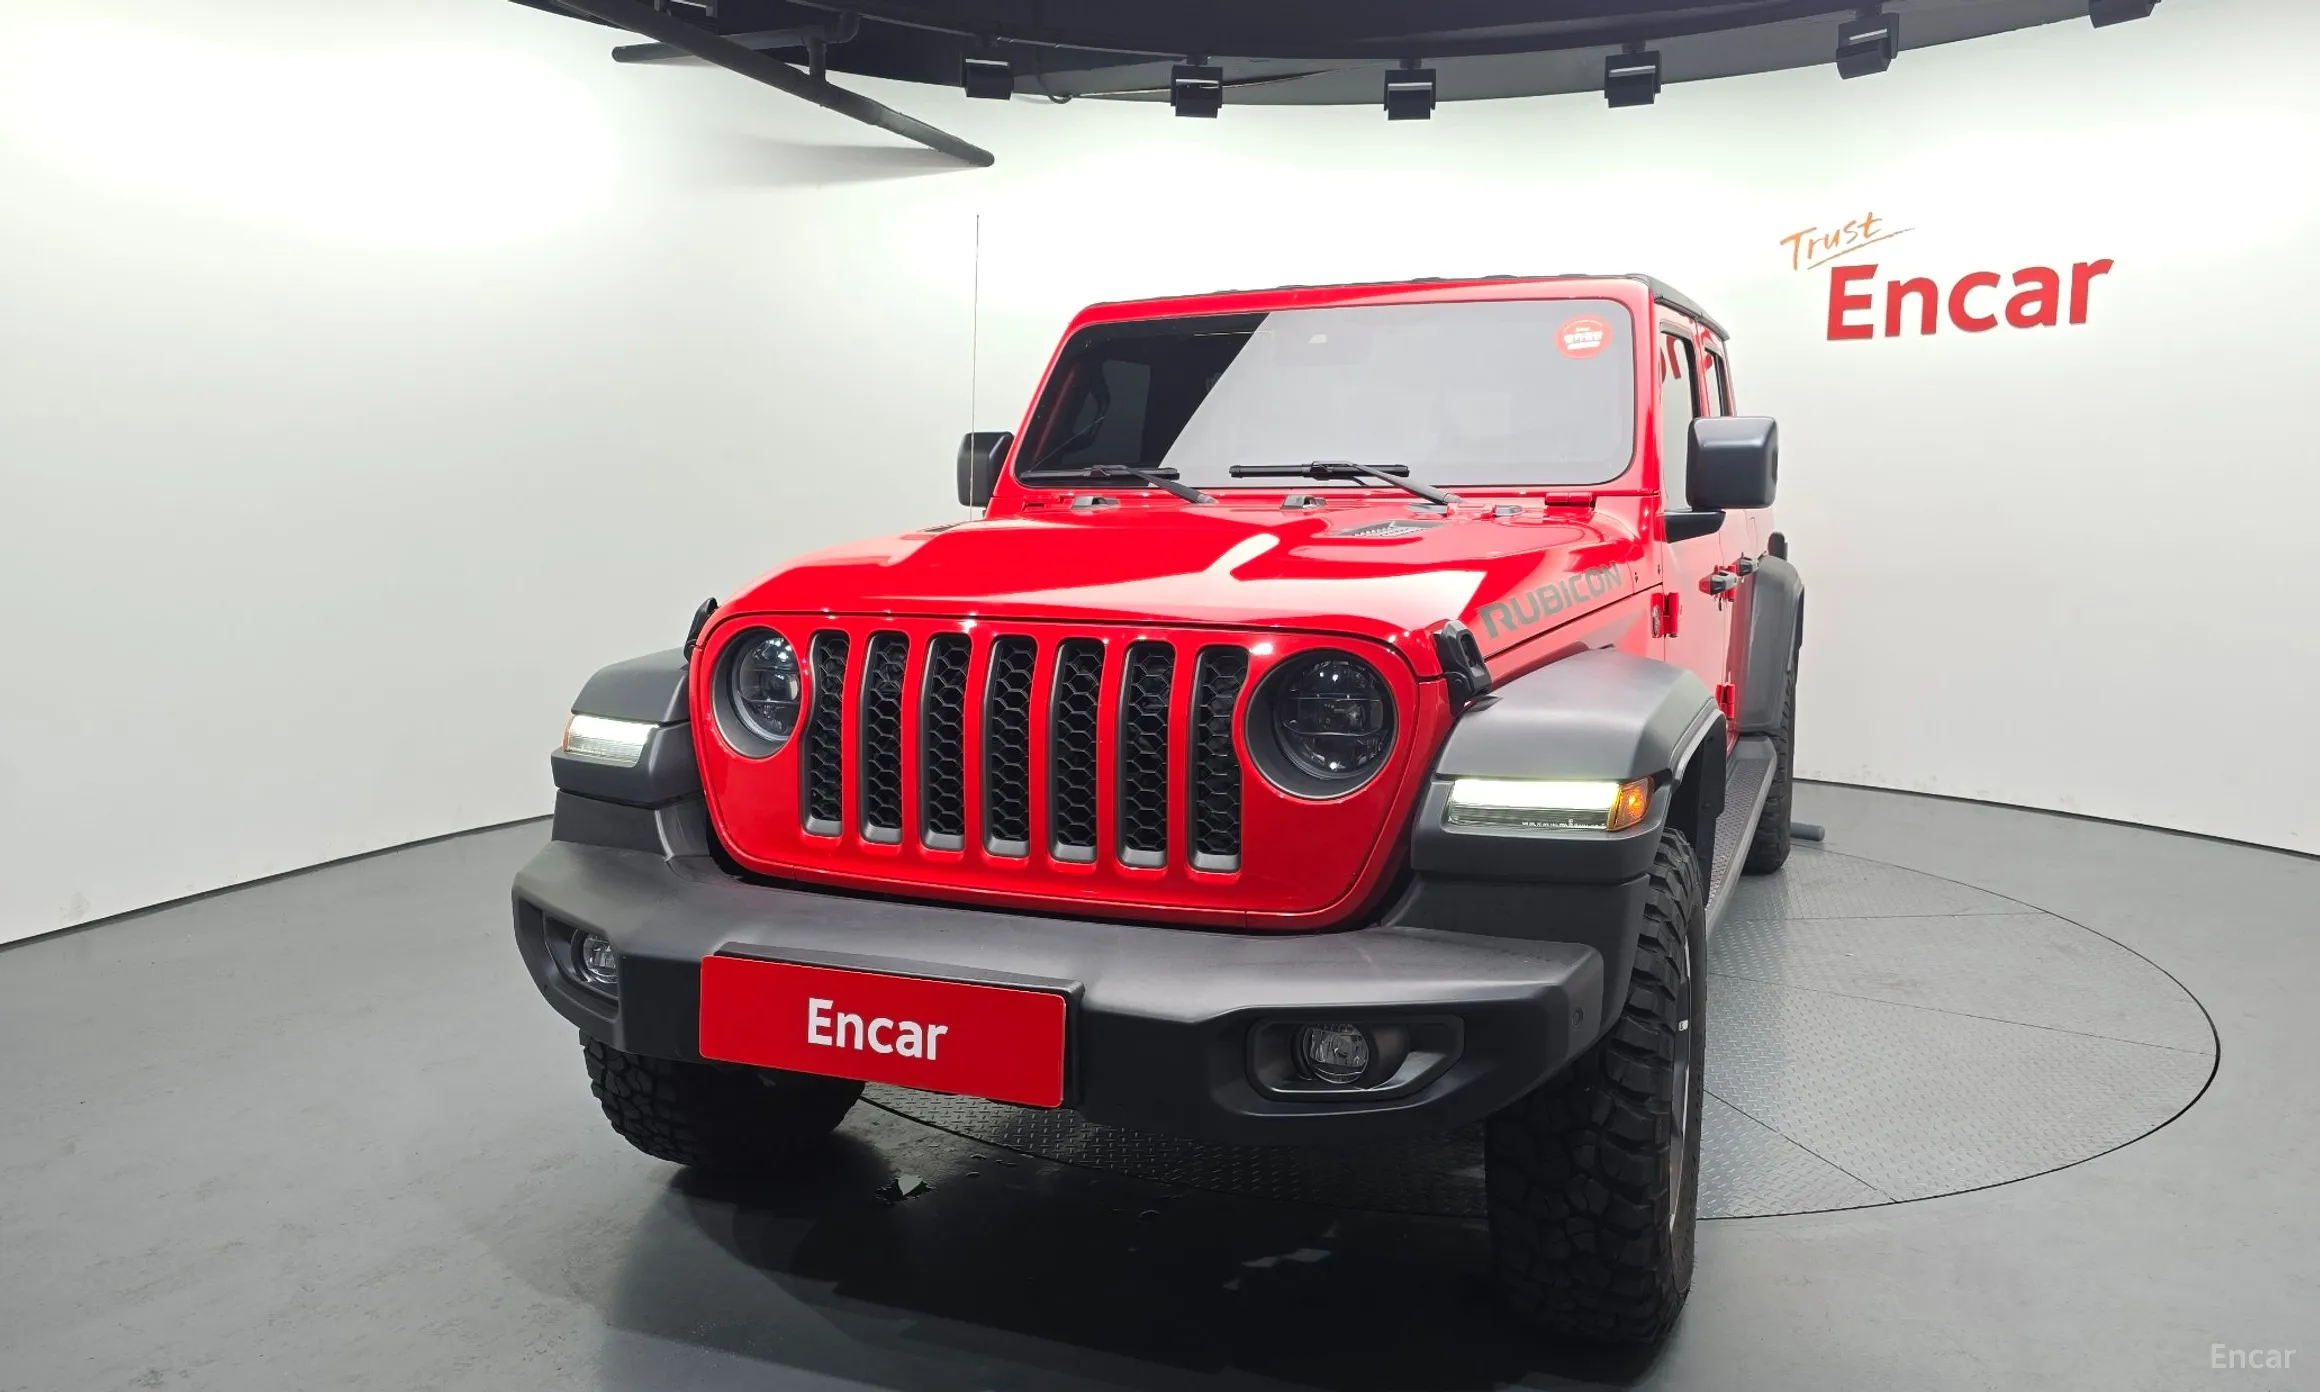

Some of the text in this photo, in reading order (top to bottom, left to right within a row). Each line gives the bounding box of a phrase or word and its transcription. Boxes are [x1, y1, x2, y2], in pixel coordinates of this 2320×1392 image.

[1780, 212, 1883, 271] Trust
[1827, 259, 2114, 341] Encar
[1479, 561, 1623, 639] RUBICON
[807, 997, 949, 1061] Encar
